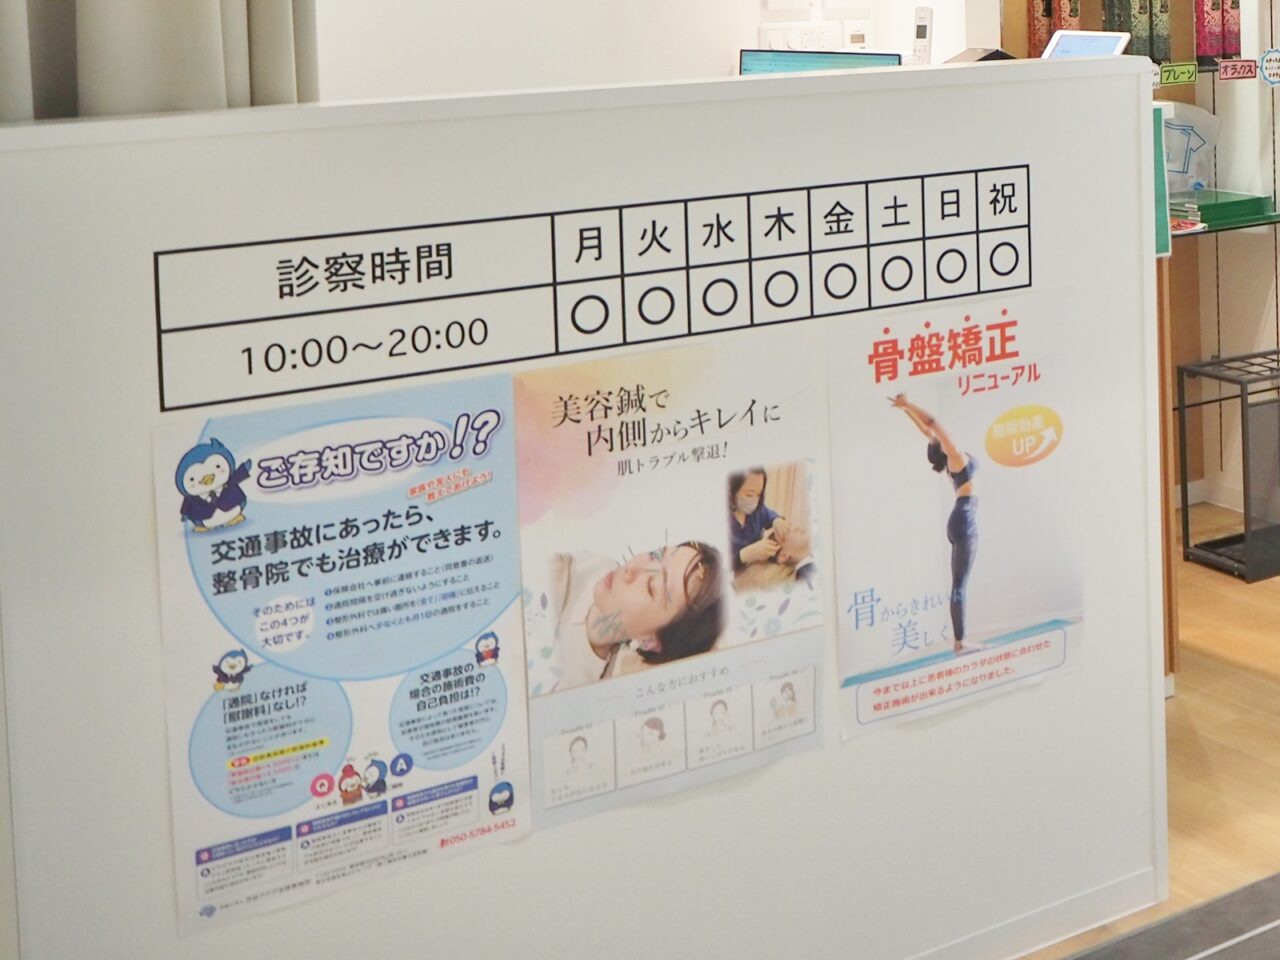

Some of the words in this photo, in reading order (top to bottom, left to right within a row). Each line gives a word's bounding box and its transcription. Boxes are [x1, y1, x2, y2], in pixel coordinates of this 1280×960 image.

[1163, 68, 1195, 82] プレーン
[574, 226, 605, 265] 月
[638, 225, 672, 258] 火
[702, 214, 736, 249] 水
[763, 205, 797, 242] 木
[823, 199, 856, 237] 金
[880, 196, 909, 229] 土
[939, 189, 960, 221] 日
[989, 183, 1019, 216] 祝
[276, 241, 454, 300] 診察時間
[867, 319, 1019, 384] 骨盤矯正
[958, 362, 1041, 396] リニューアル
[552, 383, 670, 429] 美容鍼で
[587, 398, 781, 457] 内側からキレイに
[256, 408, 502, 490] ご存知ですか!?
[617, 441, 728, 477] 肌トラブル撃退!
[1012, 435, 1036, 456] UP
[211, 503, 436, 566] 交通事故にあったら、
[211, 520, 502, 596] 整骨院でも治療ができます。
[252, 597, 316, 618] そのためには
[260, 612, 310, 633] この4つが
[261, 628, 311, 649] 大切です。
[891, 619, 949, 657] 美しく
[409, 672, 486, 700] 場合の施術費の
[420, 663, 474, 686] 交通事故の
[635, 665, 731, 699] こんな方におすすめ
[396, 757, 408, 772] A
